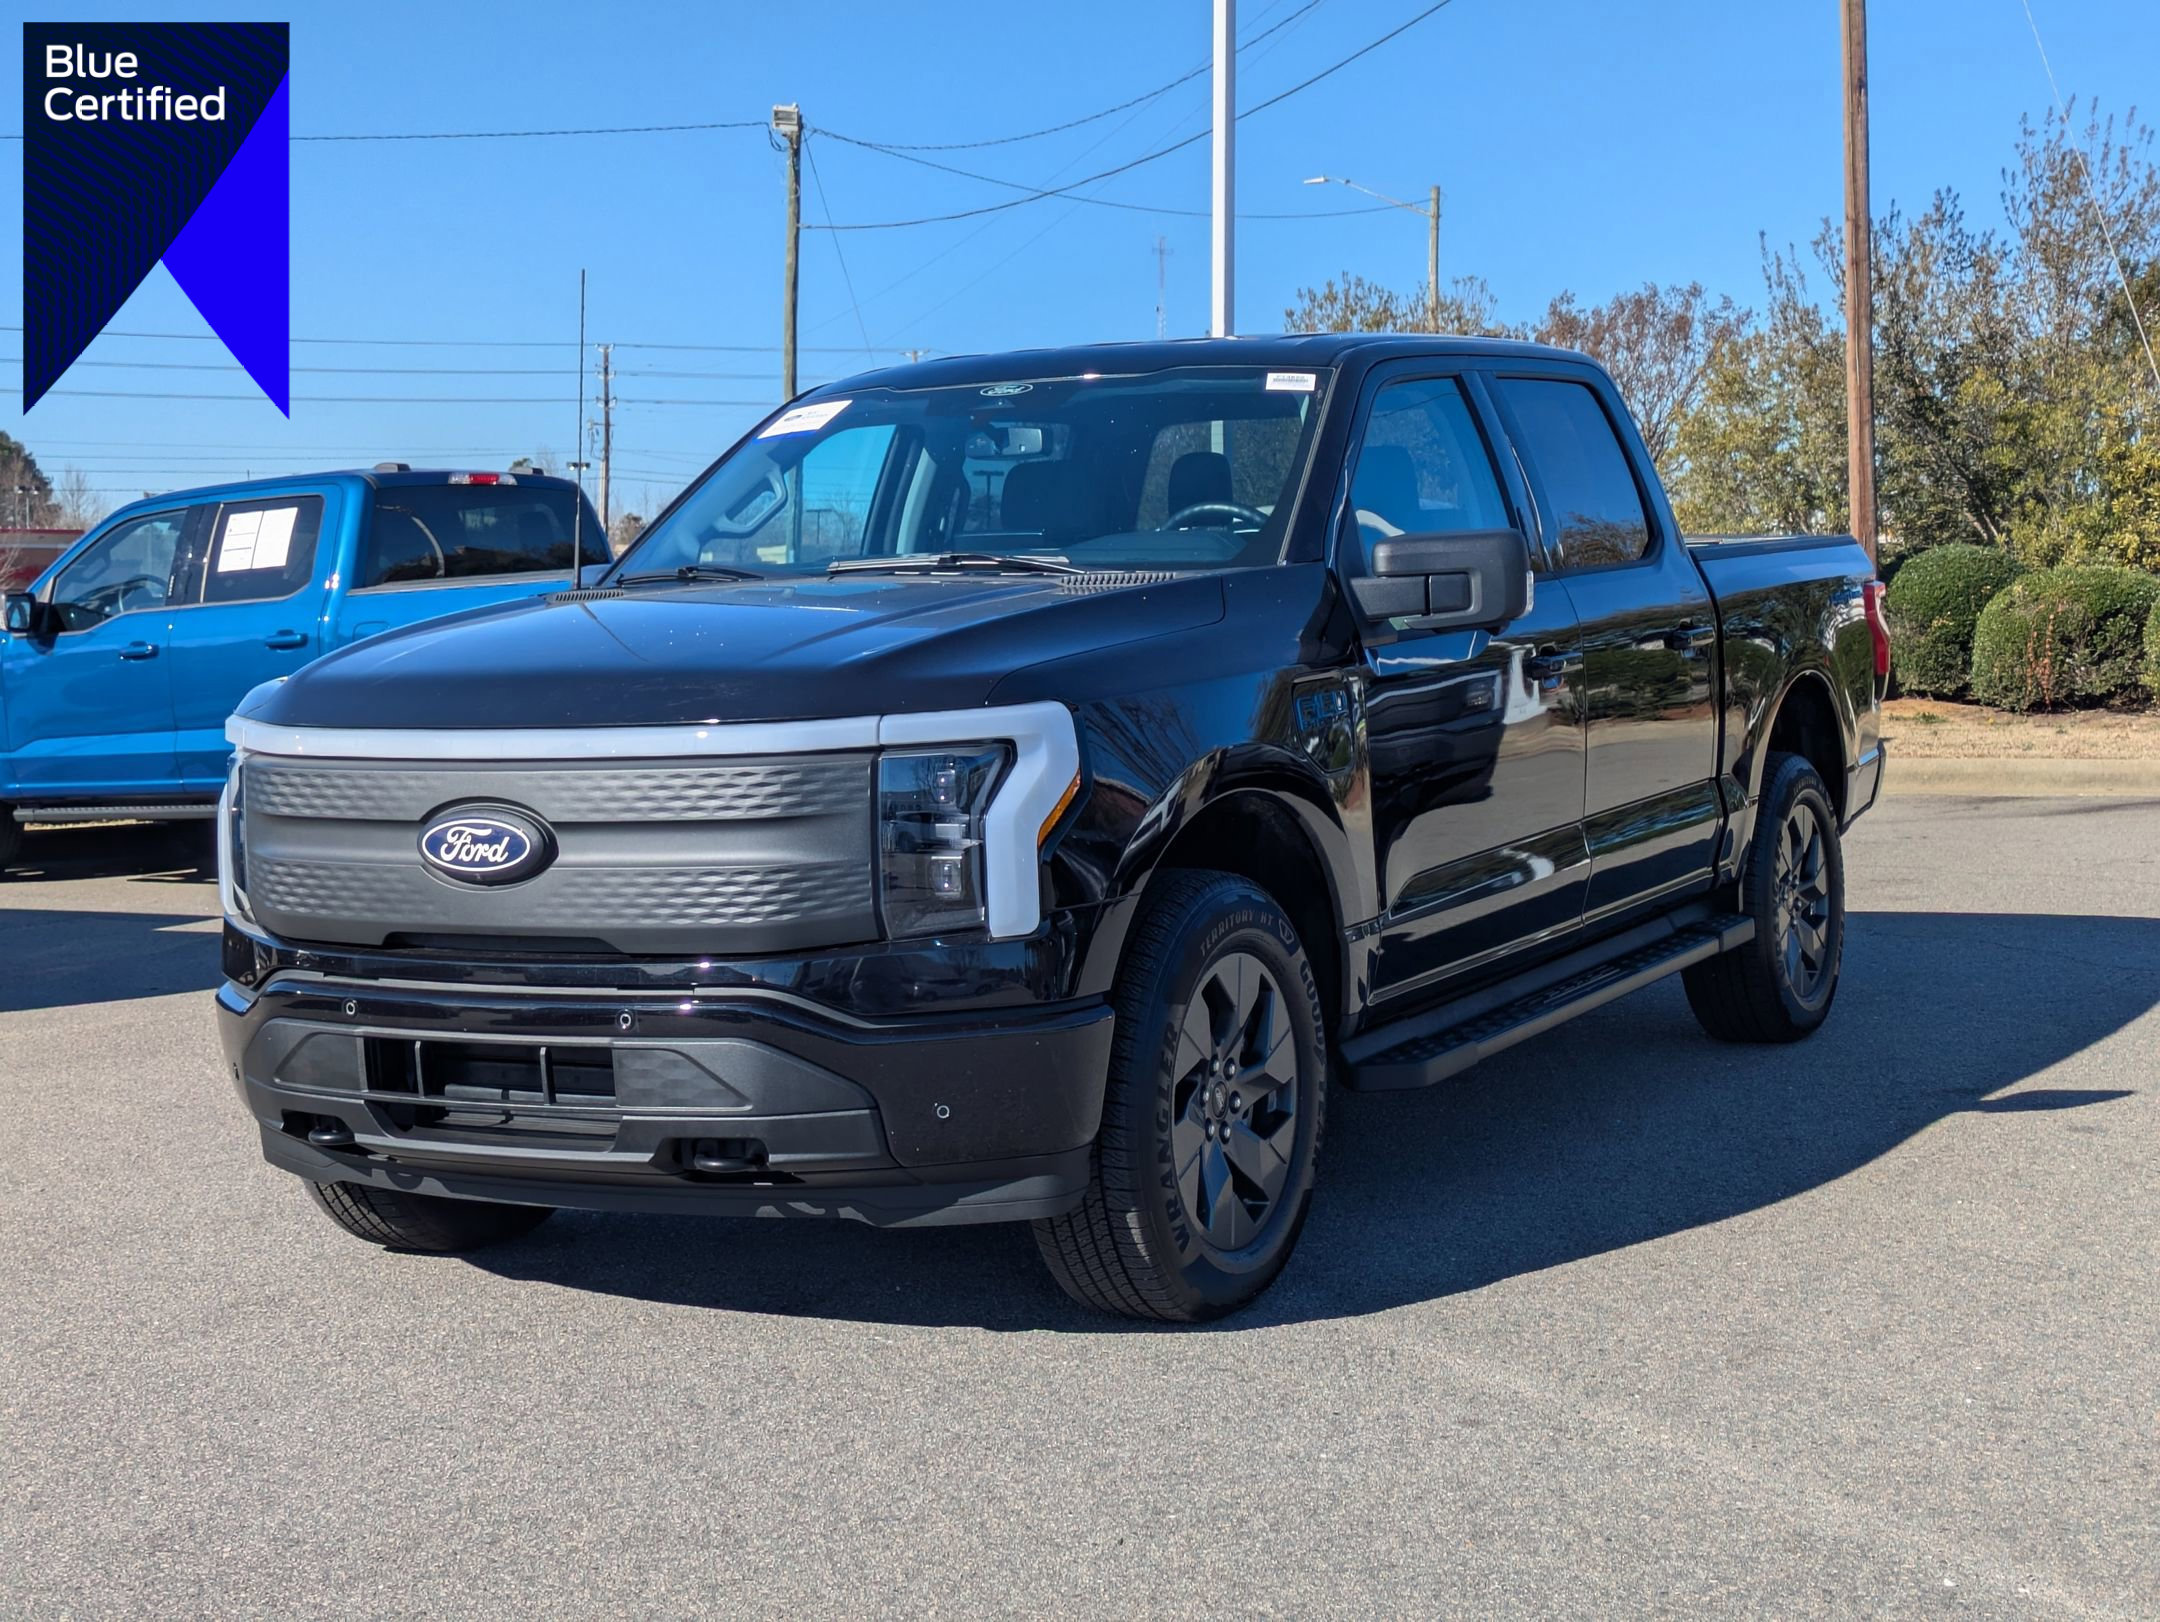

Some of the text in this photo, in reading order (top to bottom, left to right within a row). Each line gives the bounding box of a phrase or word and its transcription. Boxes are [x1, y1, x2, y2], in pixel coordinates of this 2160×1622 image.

[440, 826, 510, 862] Ford
[1200, 909, 1254, 957] TERRITORY
[1156, 1021, 1190, 1254] WRANGLER
